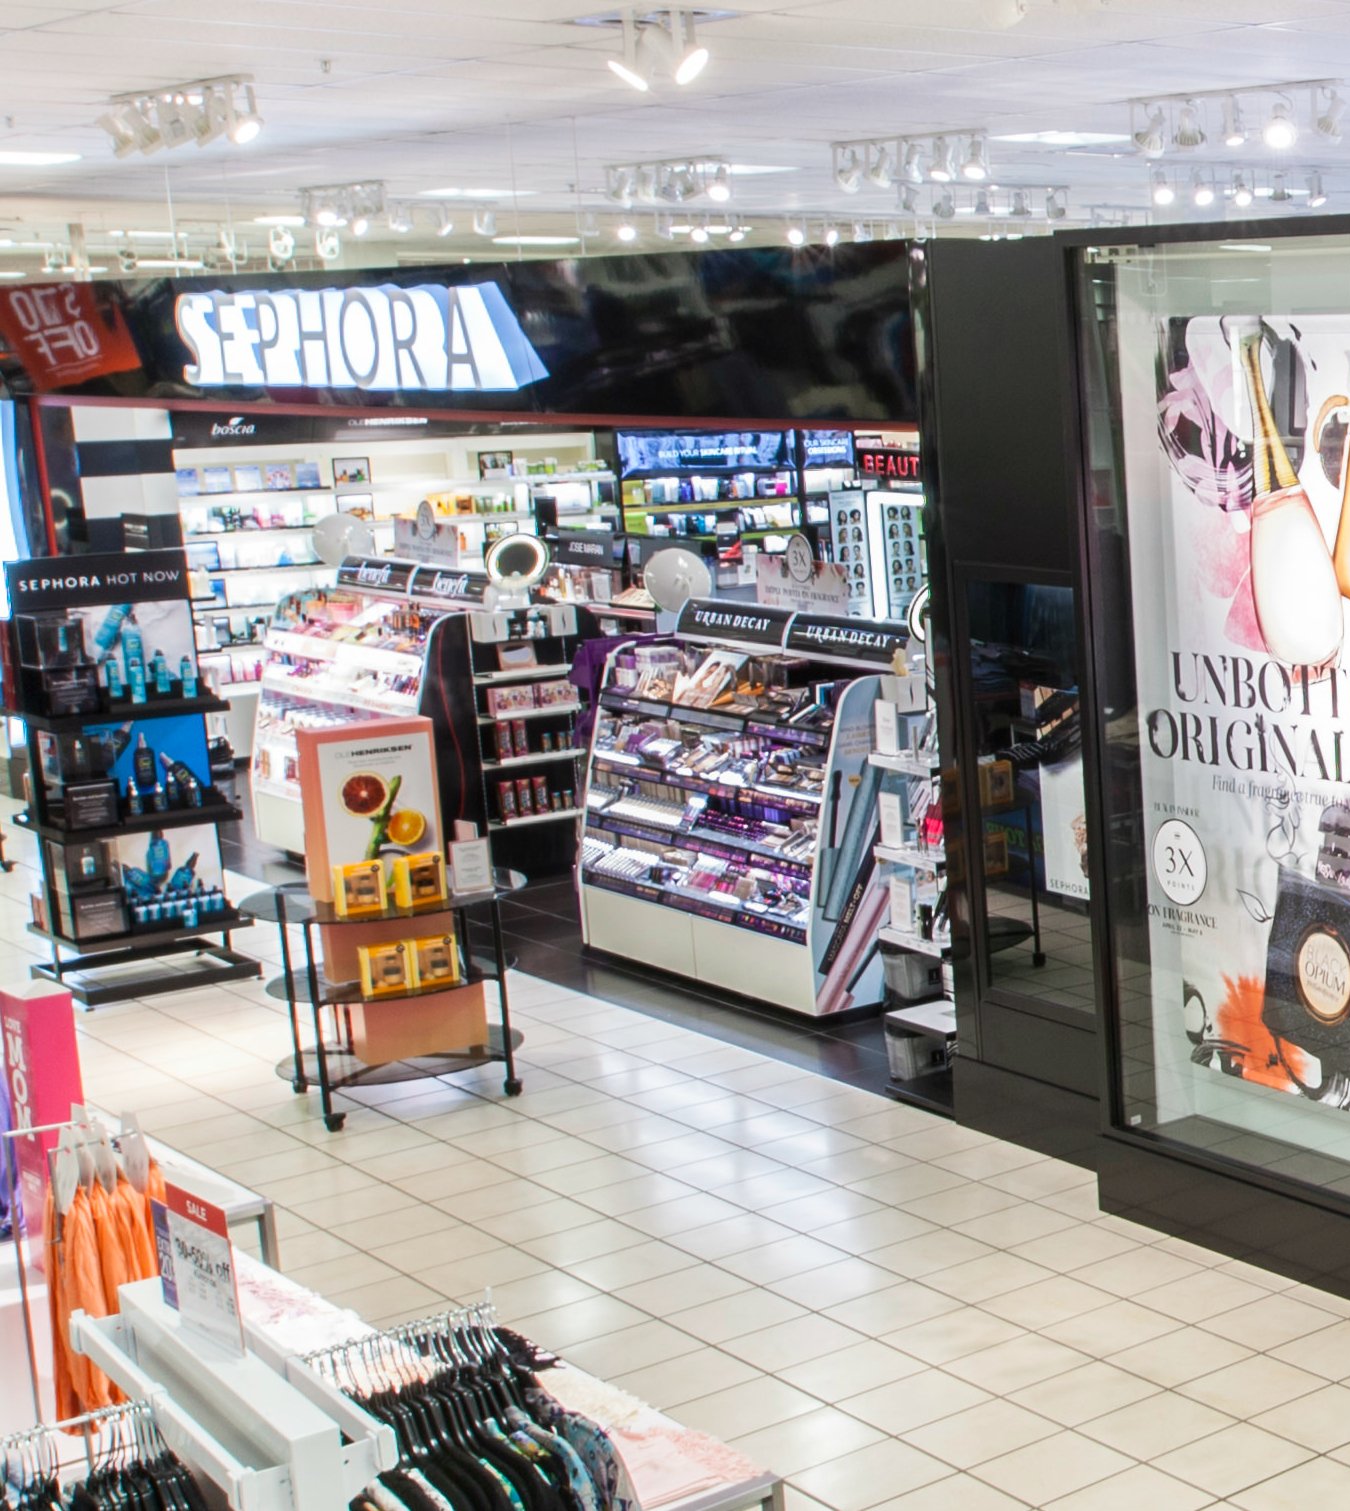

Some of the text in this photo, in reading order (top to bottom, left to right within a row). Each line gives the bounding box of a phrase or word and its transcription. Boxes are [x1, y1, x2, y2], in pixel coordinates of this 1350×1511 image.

[176, 283, 535, 391] SEPHORA
[211, 419, 256, 436] boscia
[863, 454, 919, 477] BEAUT
[18, 570, 181, 592] SEPHORA HOT NOW
[694, 609, 770, 632] URBAN DECAY
[806, 625, 891, 648] URBAN DECAY
[1212, 774, 1236, 793] Find
[1238, 783, 1246, 795] a
[1164, 846, 1194, 877] 3X
[1049, 878, 1089, 895] SEPHORA
[1162, 905, 1218, 930] FRAGRANCE
[1304, 960, 1346, 996] OPIUM
[186, 1200, 207, 1220] SALE
